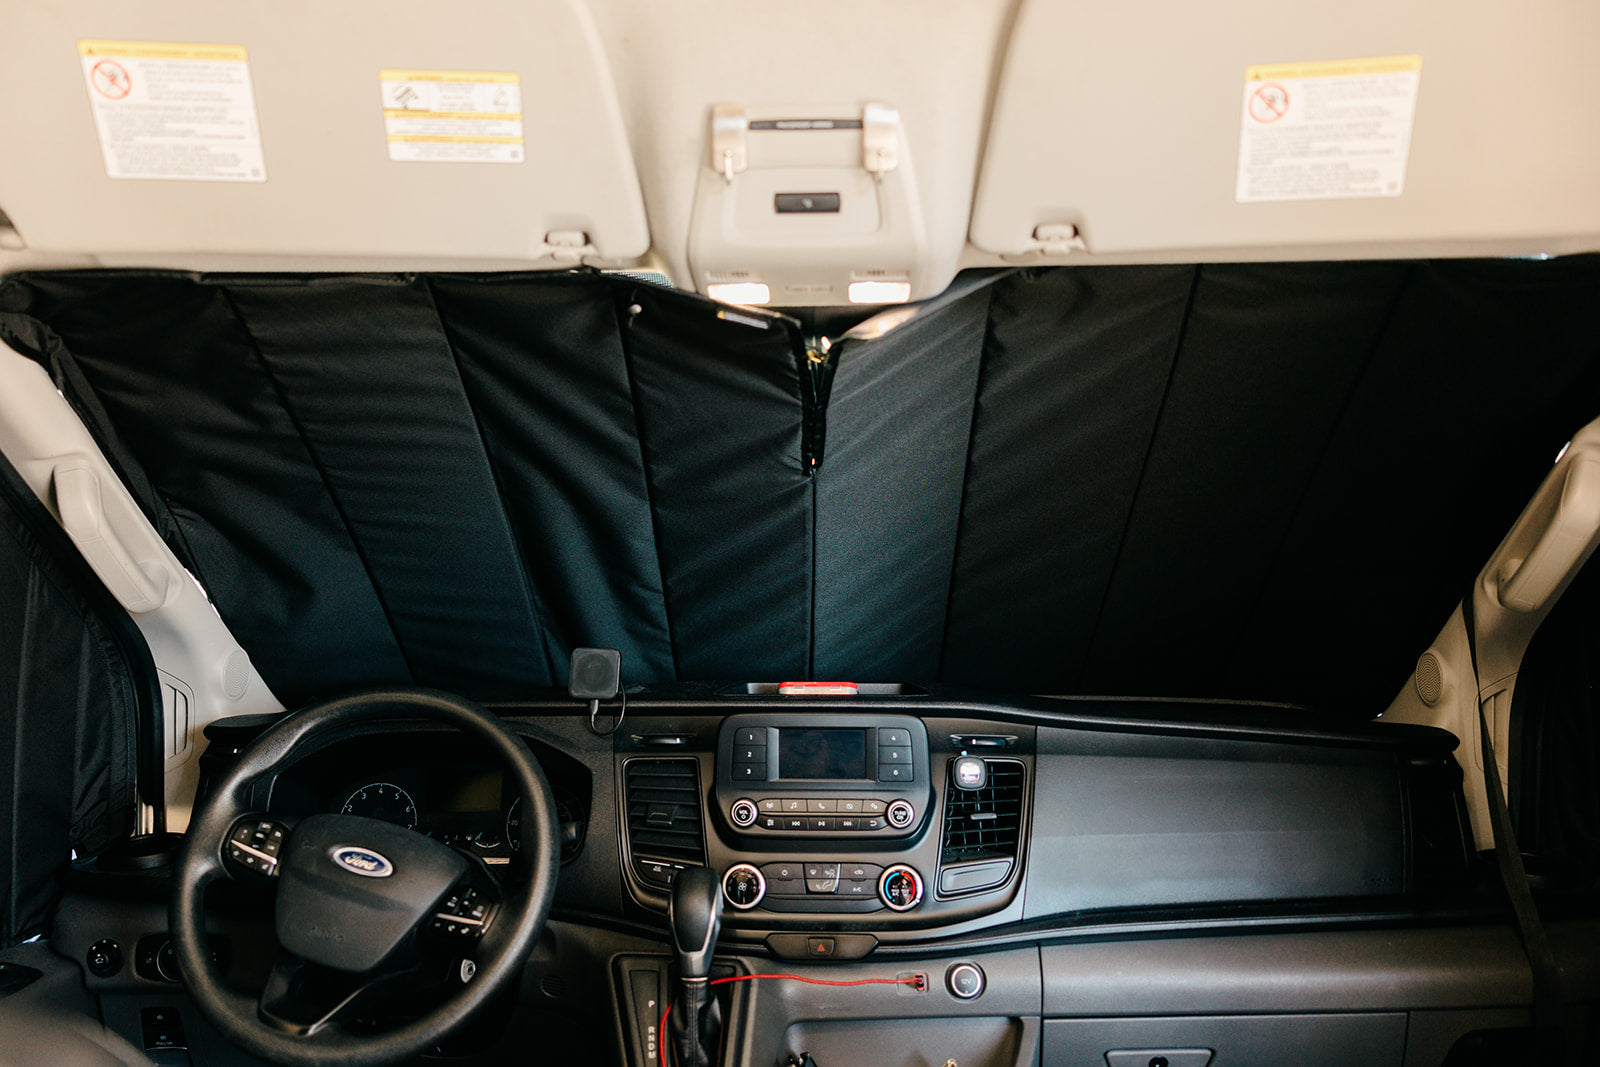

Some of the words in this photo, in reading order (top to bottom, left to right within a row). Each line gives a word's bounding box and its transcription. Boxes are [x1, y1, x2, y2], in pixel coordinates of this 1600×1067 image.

[361, 792, 367, 800] 3
[394, 792, 400, 800] 5
[347, 804, 353, 812] 2
[405, 805, 411, 813] 6
[344, 853, 379, 871] Ford
[648, 1000, 655, 1008] P
